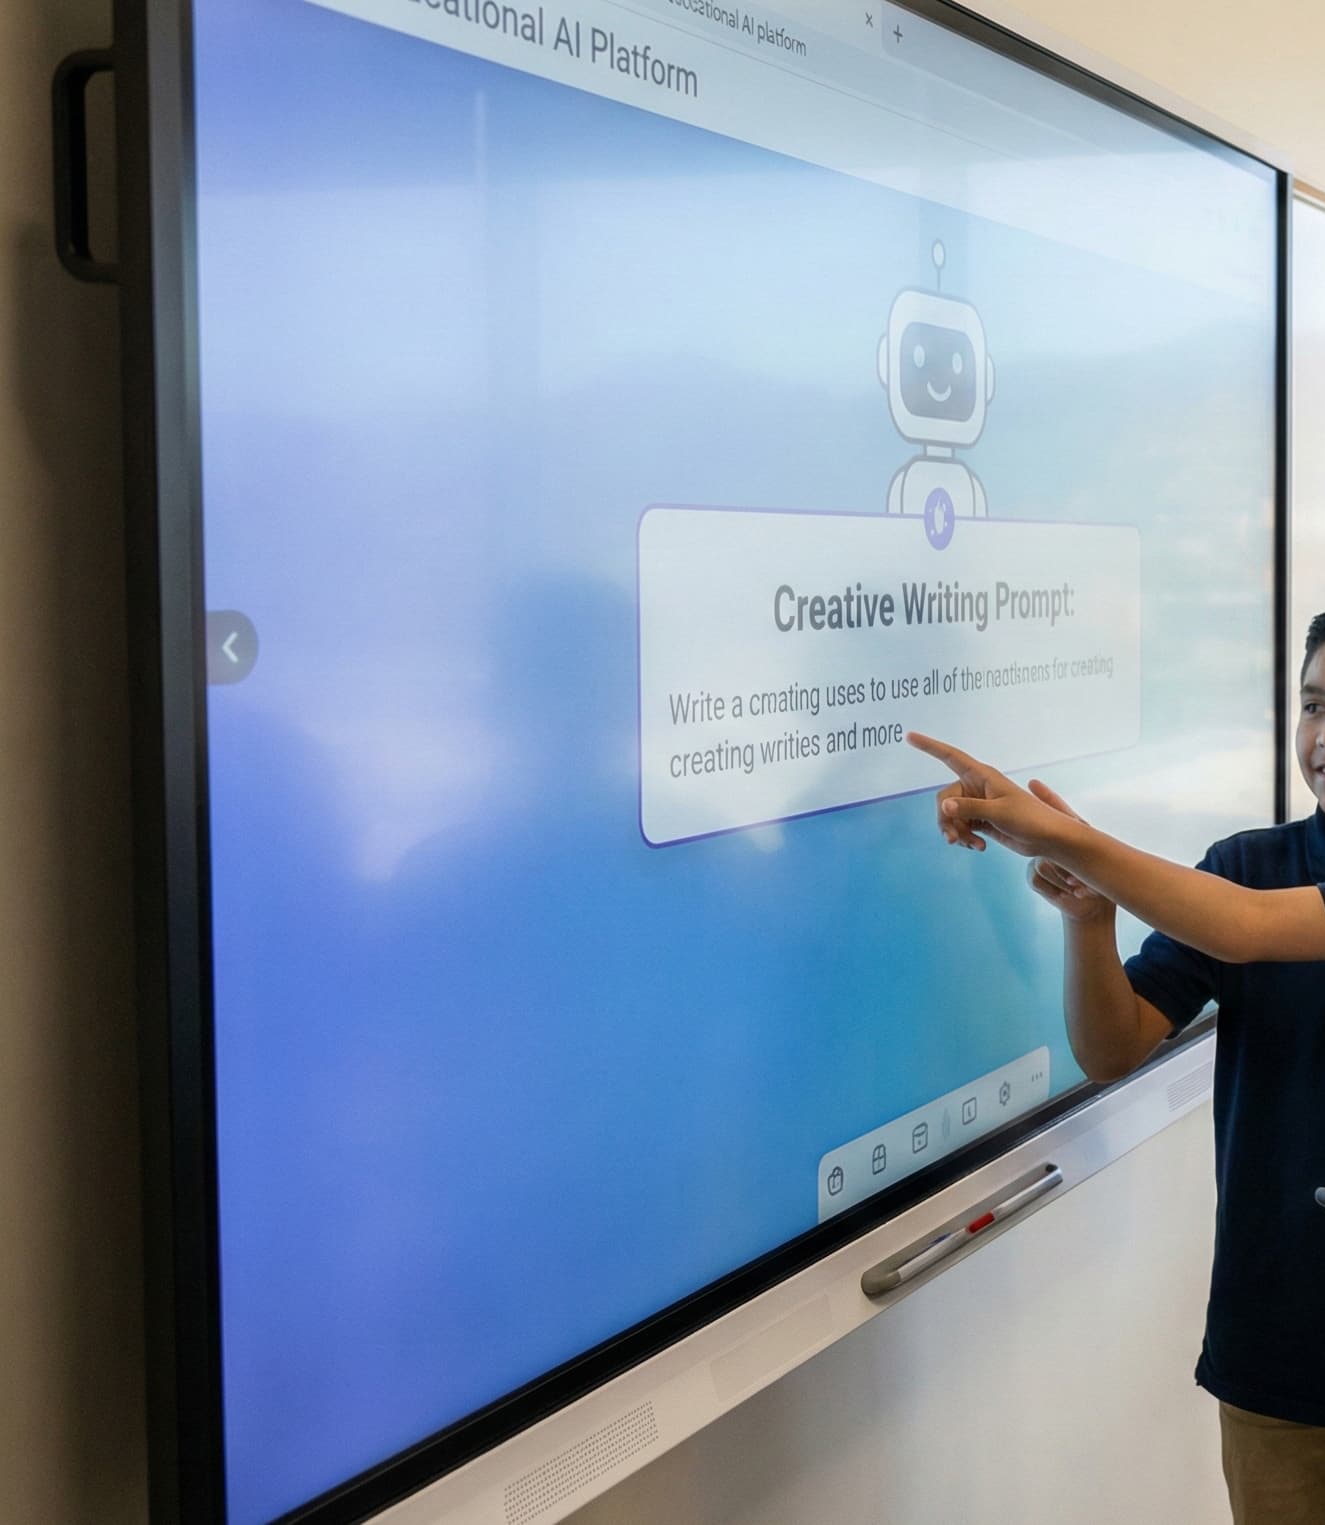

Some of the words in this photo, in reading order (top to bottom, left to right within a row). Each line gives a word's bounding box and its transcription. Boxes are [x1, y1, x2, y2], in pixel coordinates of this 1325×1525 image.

[408, 0, 543, 45] ational
[553, 16, 580, 58] AI
[591, 27, 698, 97] Platform
[742, 14, 754, 35] AI
[757, 21, 807, 56] platform
[773, 582, 895, 633] Creative
[902, 580, 989, 632] Writing
[996, 581, 1075, 627] Prompt:
[669, 690, 725, 726] Write
[732, 695, 743, 719] a
[826, 682, 865, 708] uses
[870, 677, 886, 702] to
[891, 676, 919, 700] use
[923, 669, 939, 697] all
[943, 666, 958, 694] of
[961, 665, 983, 692] the
[670, 739, 754, 779] creating
[760, 729, 820, 765] writies
[826, 722, 857, 754] and
[862, 722, 903, 749] more
